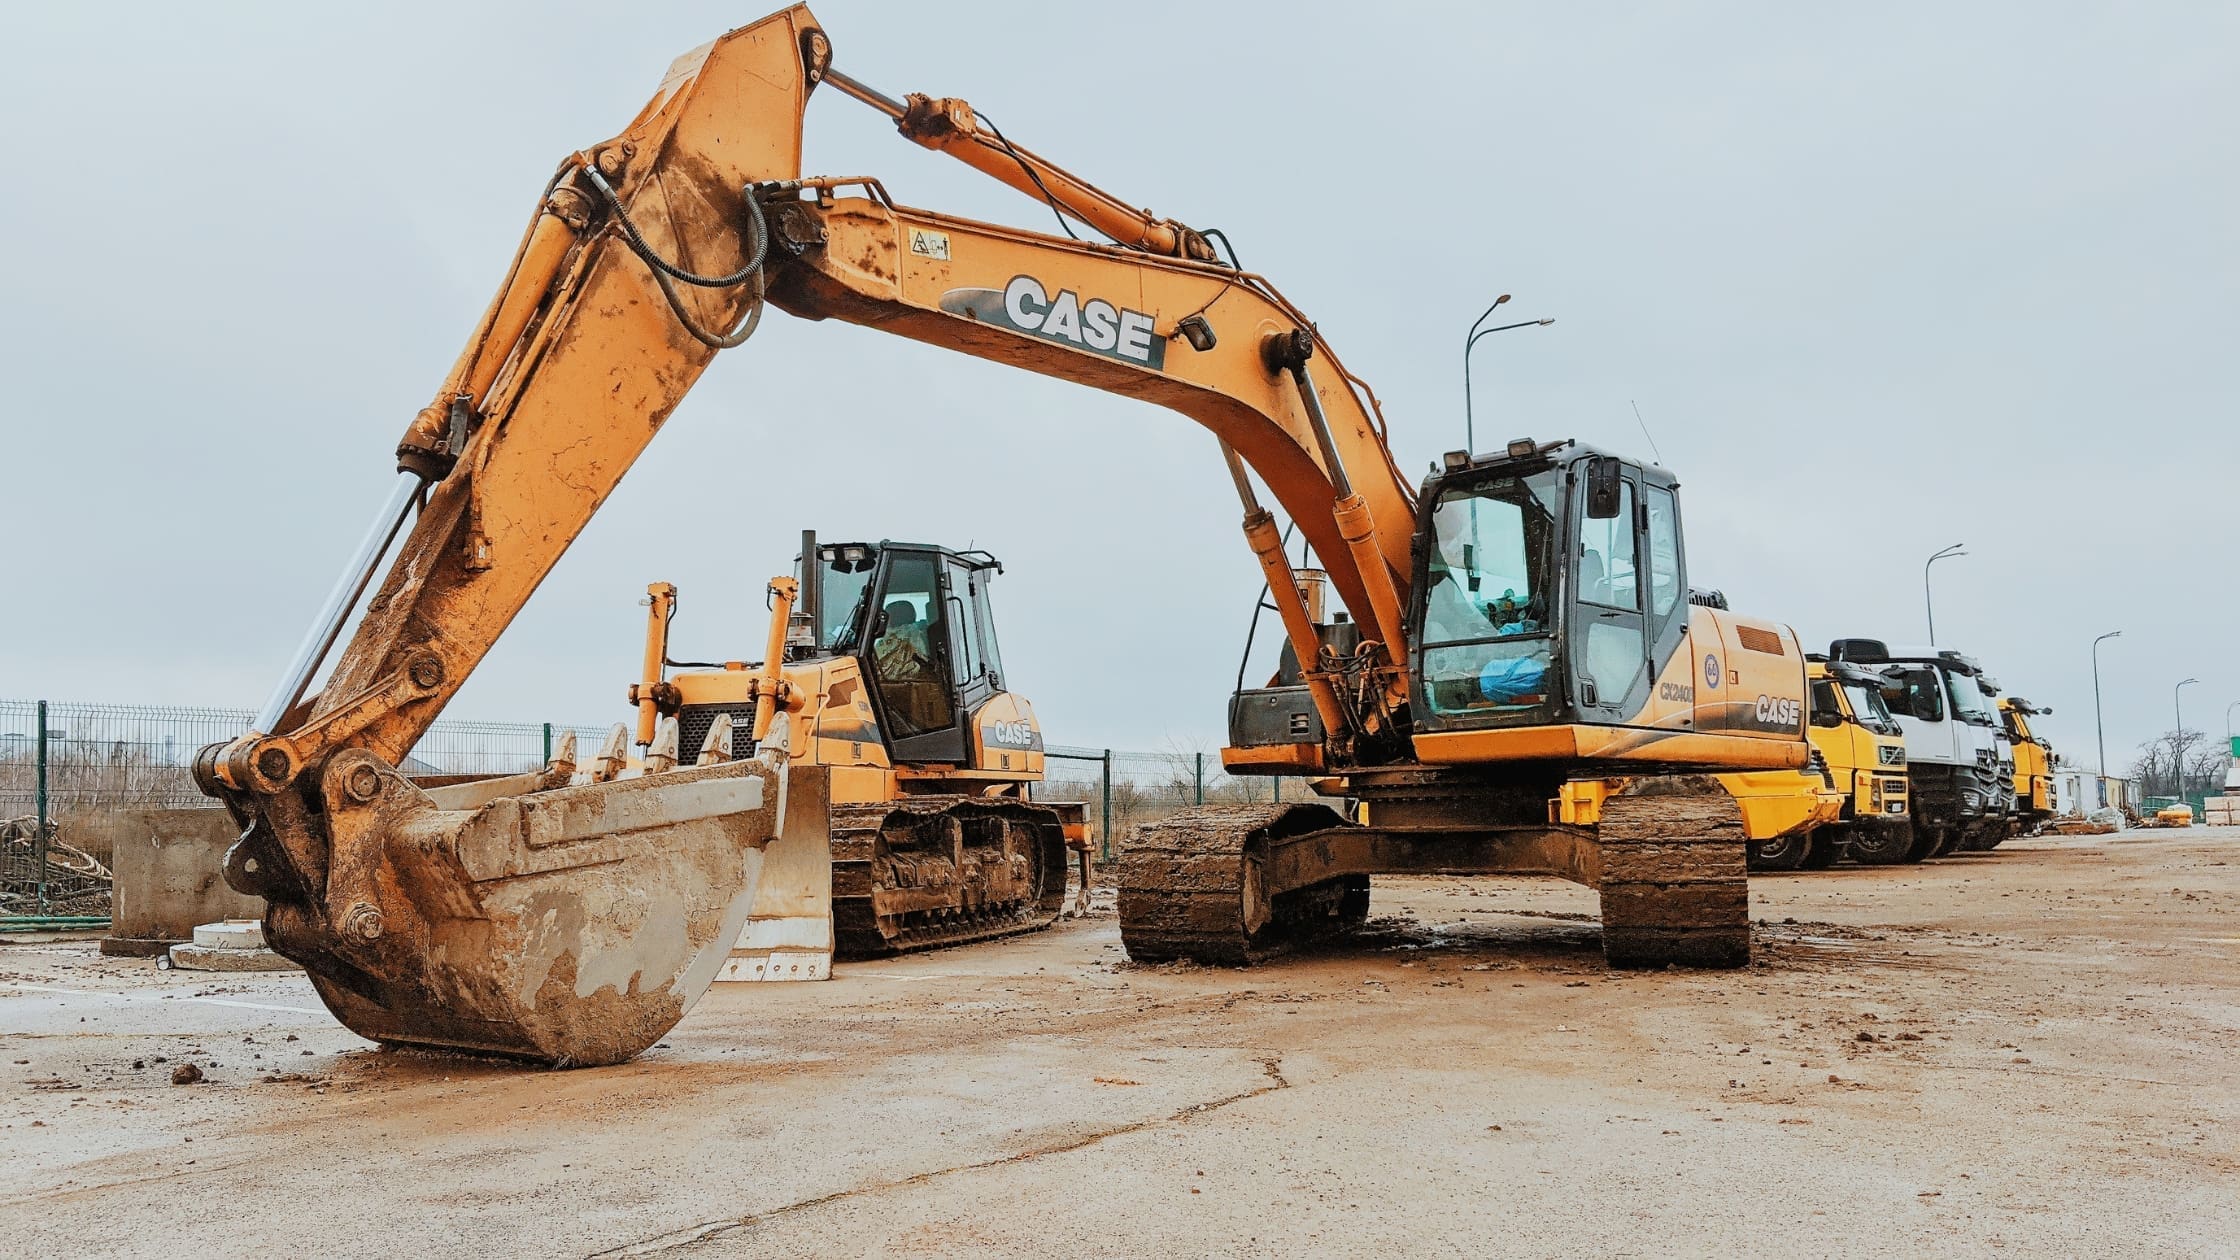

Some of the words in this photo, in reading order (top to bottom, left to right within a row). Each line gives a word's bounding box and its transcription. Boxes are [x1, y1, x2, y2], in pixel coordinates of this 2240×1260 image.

[1005, 276, 1155, 361] CASE
[1473, 477, 1515, 491] CASE
[1756, 695, 1800, 726] CASE
[995, 720, 1032, 745] CASE
